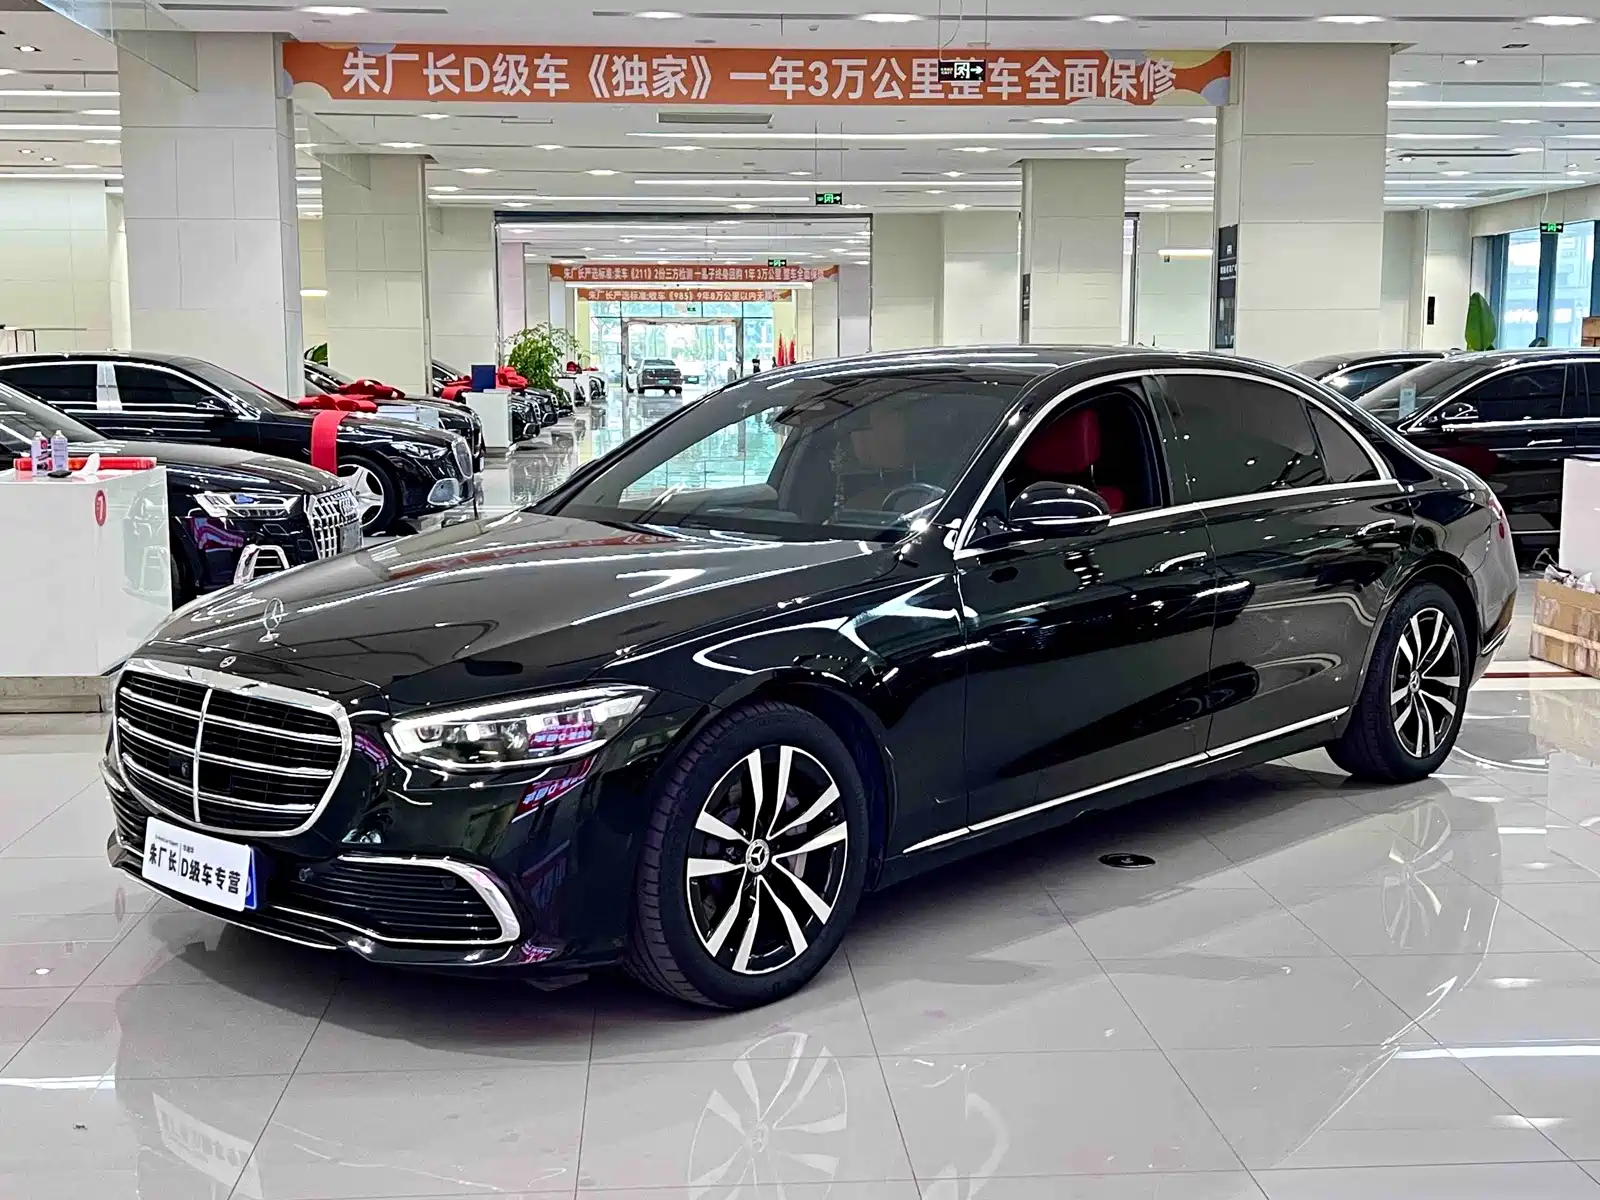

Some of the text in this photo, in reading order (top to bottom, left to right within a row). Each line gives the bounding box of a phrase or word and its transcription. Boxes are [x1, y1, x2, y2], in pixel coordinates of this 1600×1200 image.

[149, 843, 241, 895] 朱厂长 D级车专营
